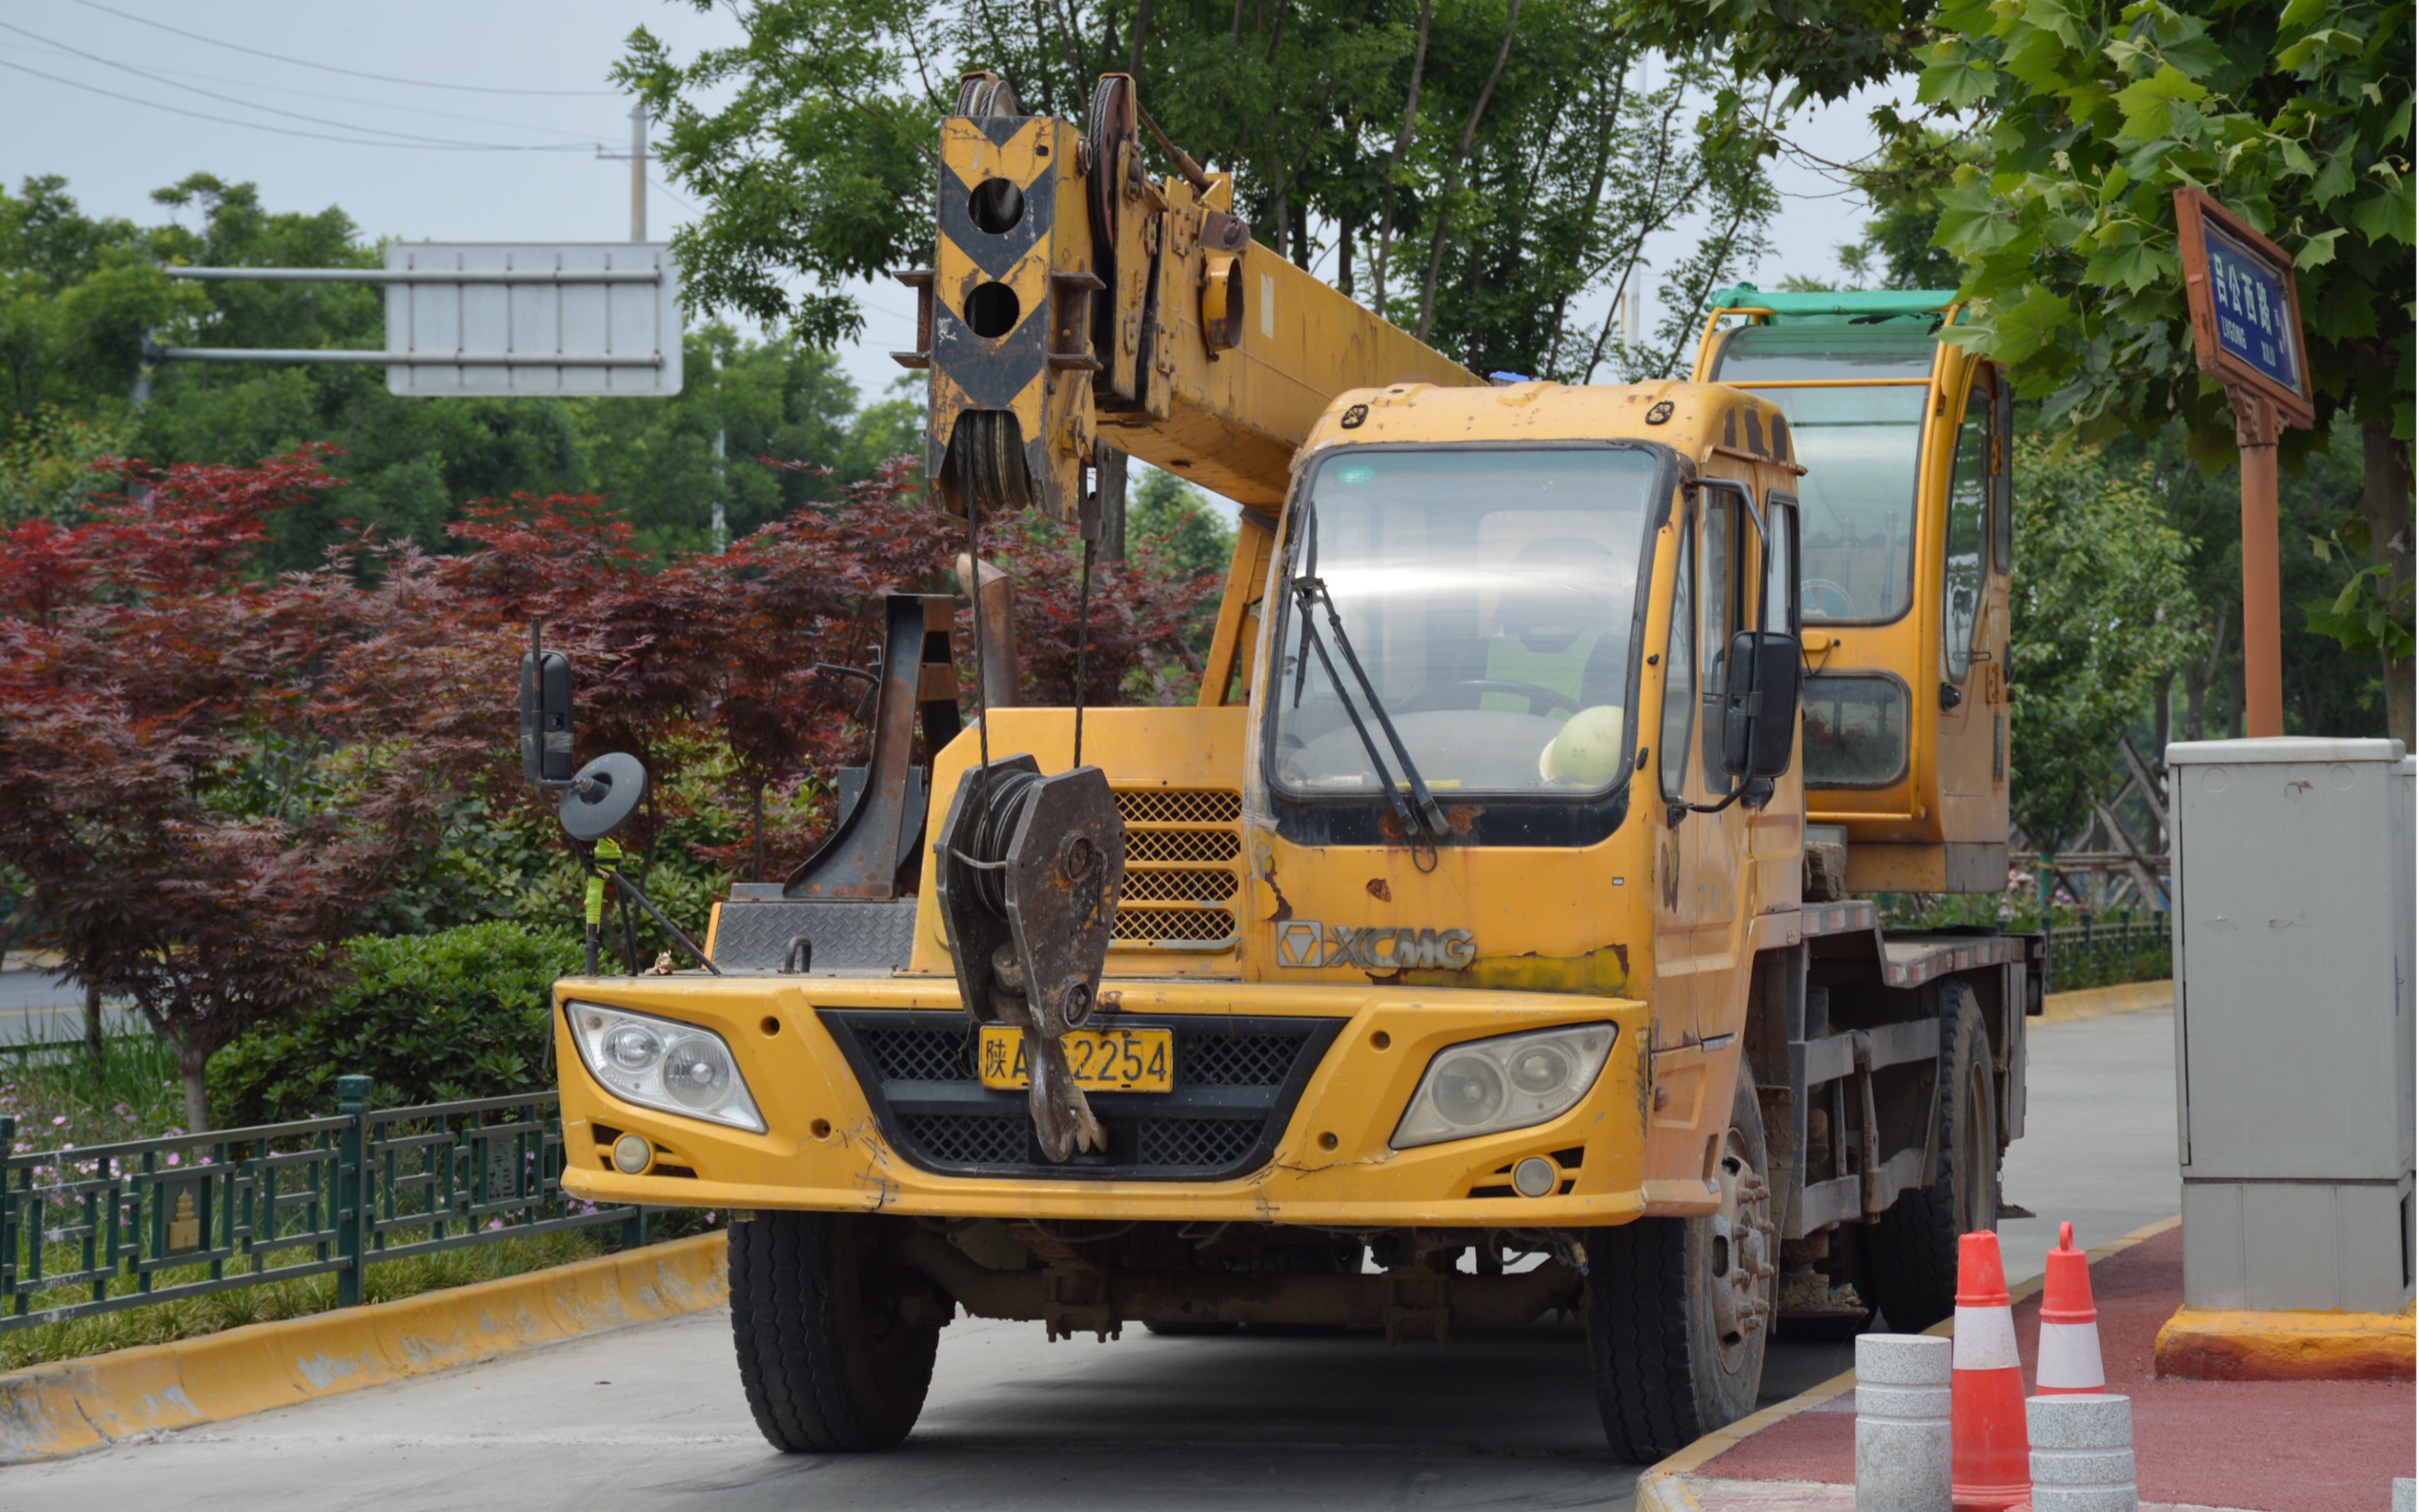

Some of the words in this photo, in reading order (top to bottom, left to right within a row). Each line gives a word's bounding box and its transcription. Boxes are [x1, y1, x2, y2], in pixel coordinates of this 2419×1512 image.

[2213, 253, 2272, 335] 吕公西路
[1322, 926, 1476, 970] XCMG
[985, 1038, 1166, 1082] 陕A2254
